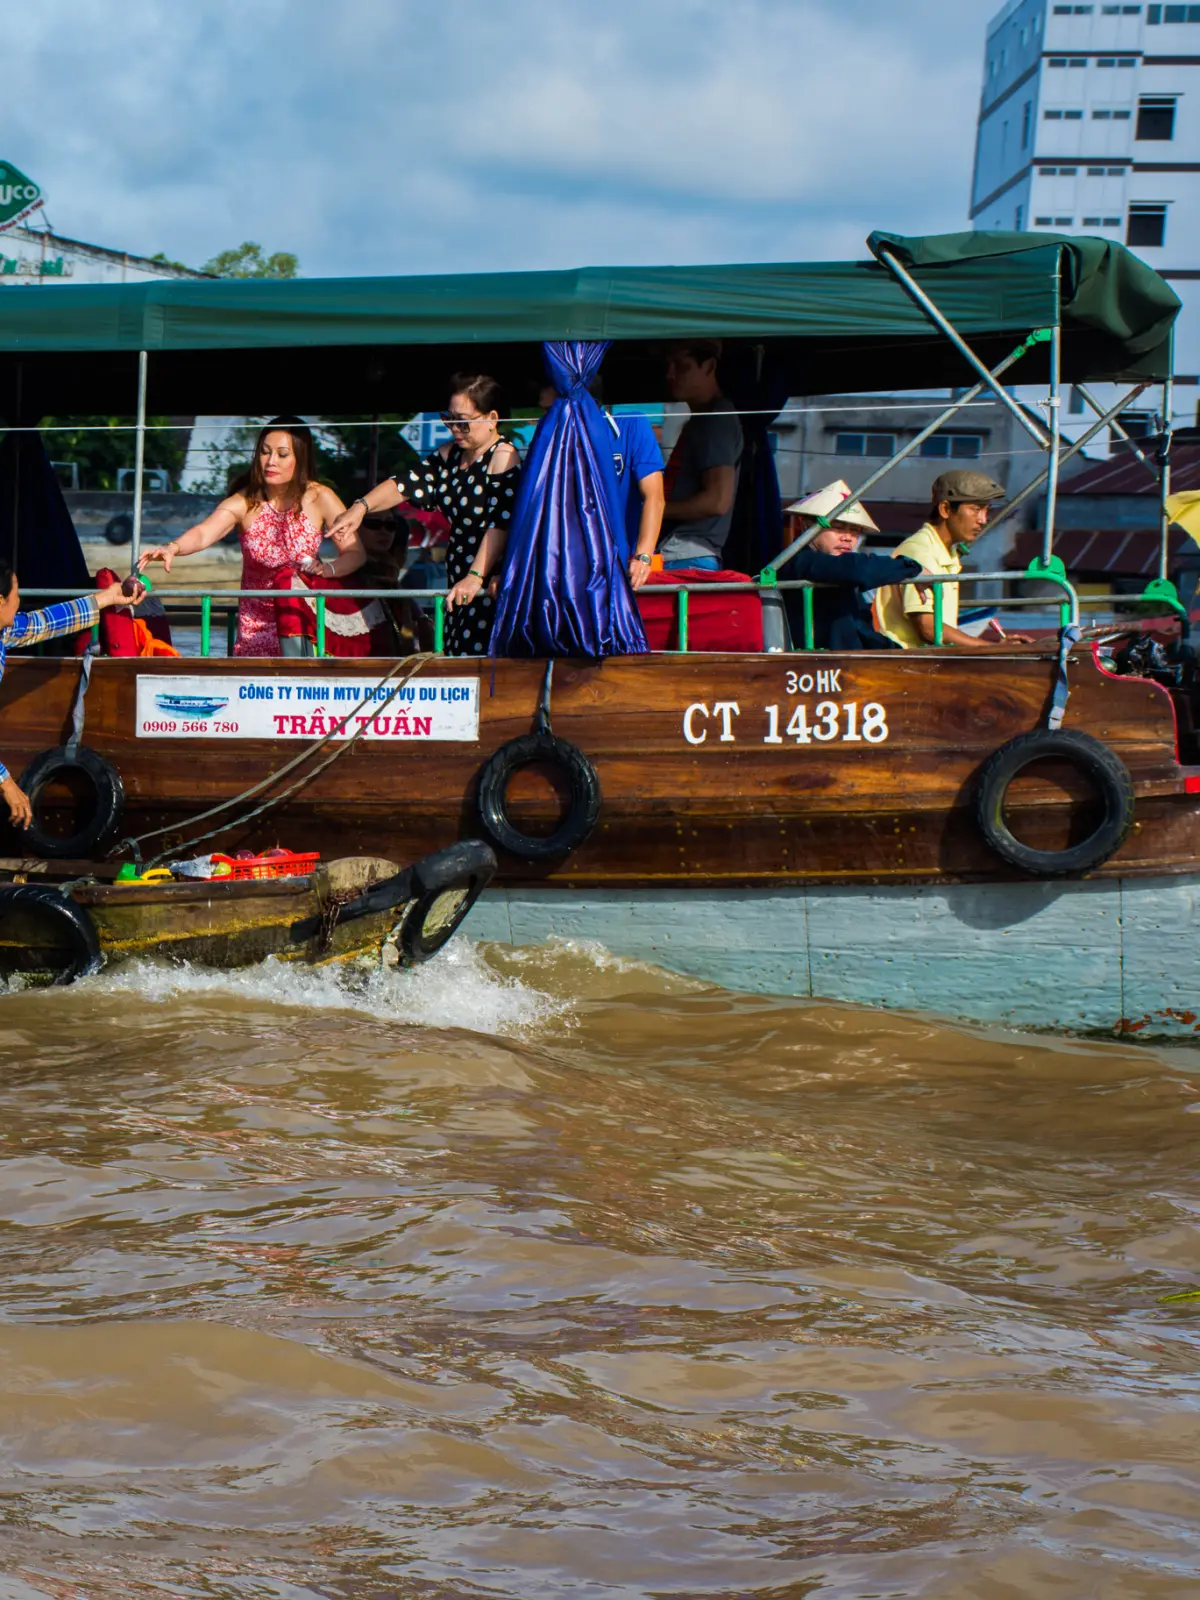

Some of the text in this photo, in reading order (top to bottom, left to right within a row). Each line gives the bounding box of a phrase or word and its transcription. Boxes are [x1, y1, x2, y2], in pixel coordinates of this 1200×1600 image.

[239, 683, 470, 704] CÔNG TY TNHH MTV DỊCH VỤ DU LỊCH
[143, 720, 239, 733] 0909 566 780
[273, 706, 433, 736] TRẦN TUẤN
[683, 701, 889, 745] CT 14318
